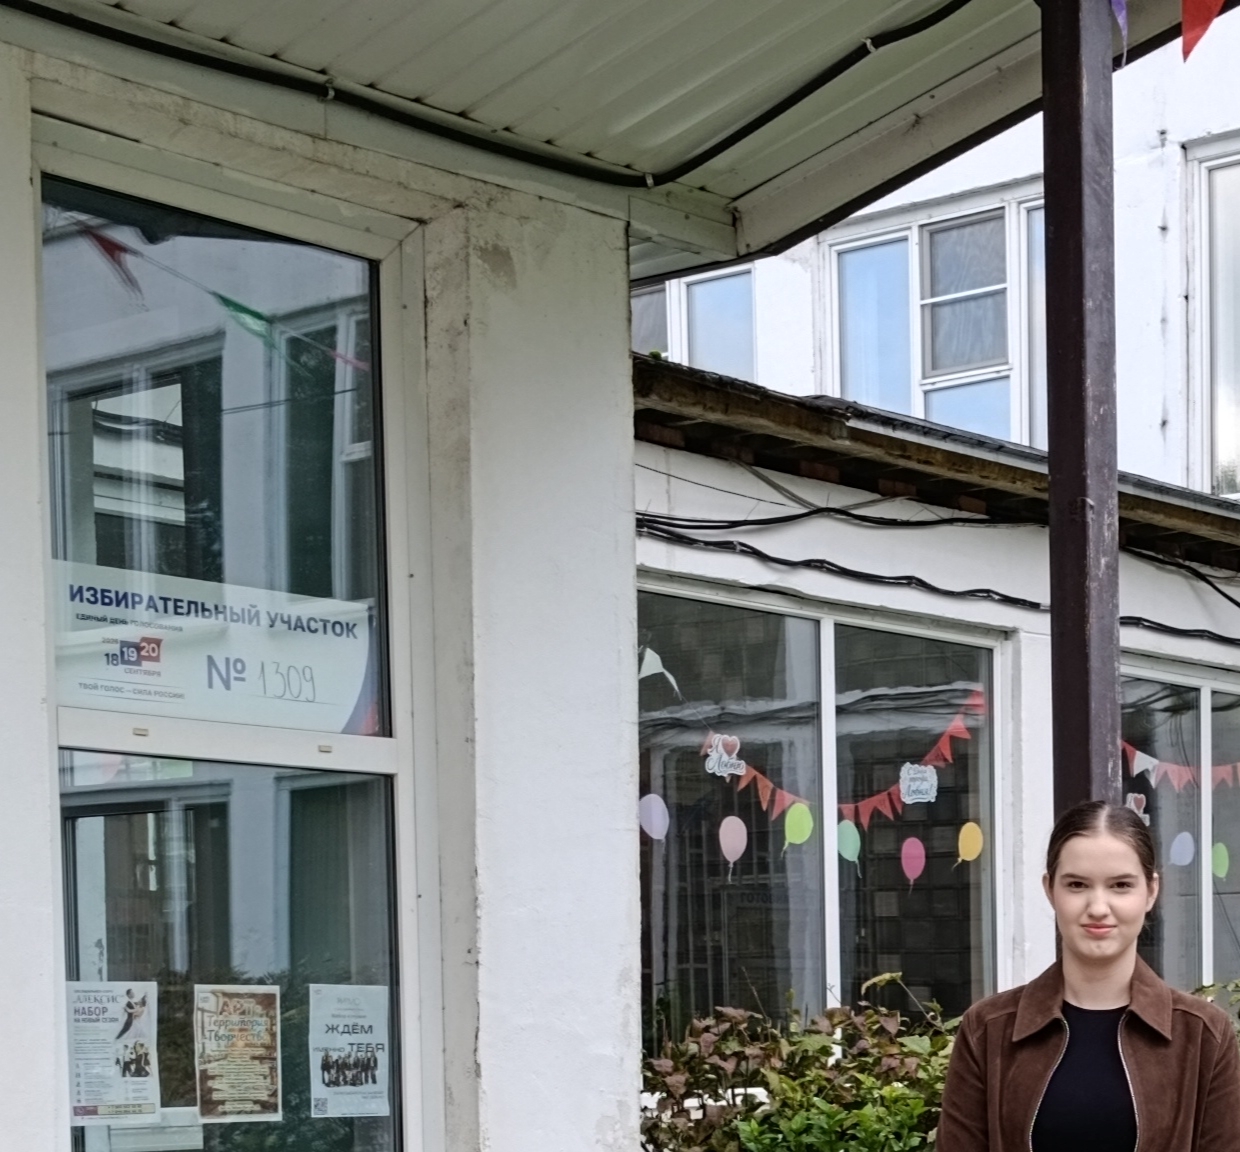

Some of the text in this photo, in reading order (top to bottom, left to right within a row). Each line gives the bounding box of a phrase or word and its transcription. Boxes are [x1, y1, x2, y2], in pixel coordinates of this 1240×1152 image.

[69, 584, 358, 640] ИЗБИРАТЕЛЬНЫЙ УЧАСТОК
[104, 642, 159, 667] 18 19 20
[100, 684, 125, 694] ГОЛОС
[258, 661, 316, 703] 1309
[74, 1006, 108, 1017] НАБОР
[325, 1022, 374, 1036] ЖДЁМ
[347, 1042, 386, 1053] ТЕБЯ
